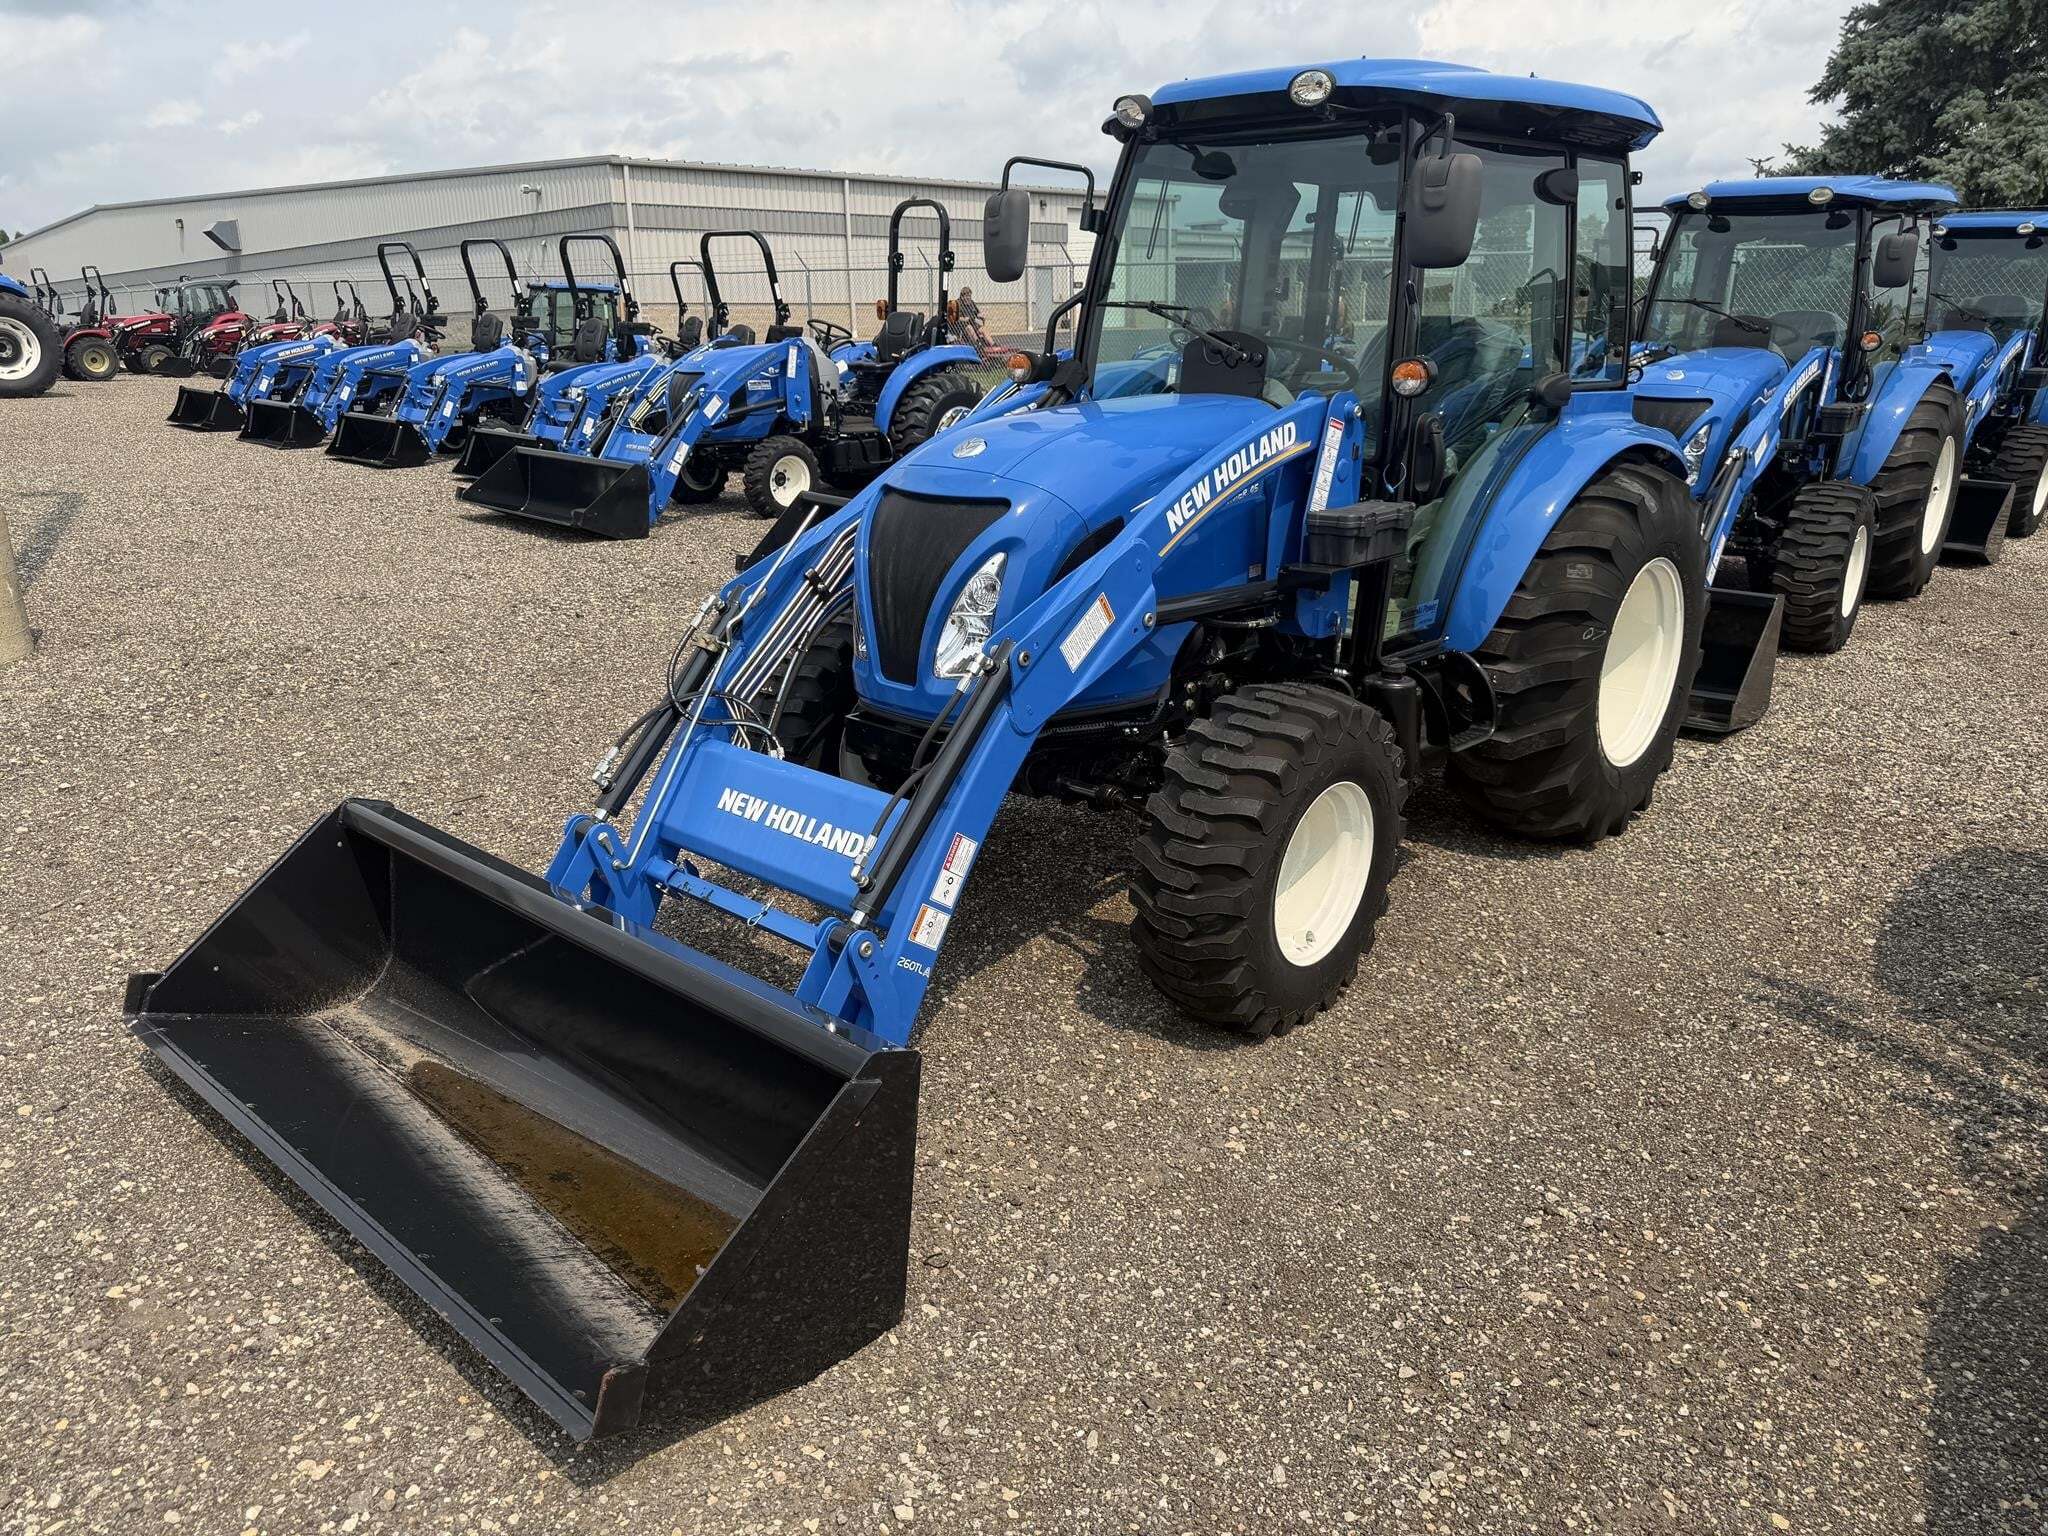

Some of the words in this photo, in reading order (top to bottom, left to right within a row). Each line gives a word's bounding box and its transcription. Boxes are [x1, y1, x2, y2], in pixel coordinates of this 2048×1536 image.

[278, 349, 290, 358] NEW
[291, 344, 315, 355] HOLLAND
[1165, 475, 1211, 535] NEW
[1213, 421, 1297, 493] HOLLAND
[717, 787, 769, 823] NEW
[764, 804, 866, 859] HOLLAND
[896, 956, 932, 978] 260TLA
